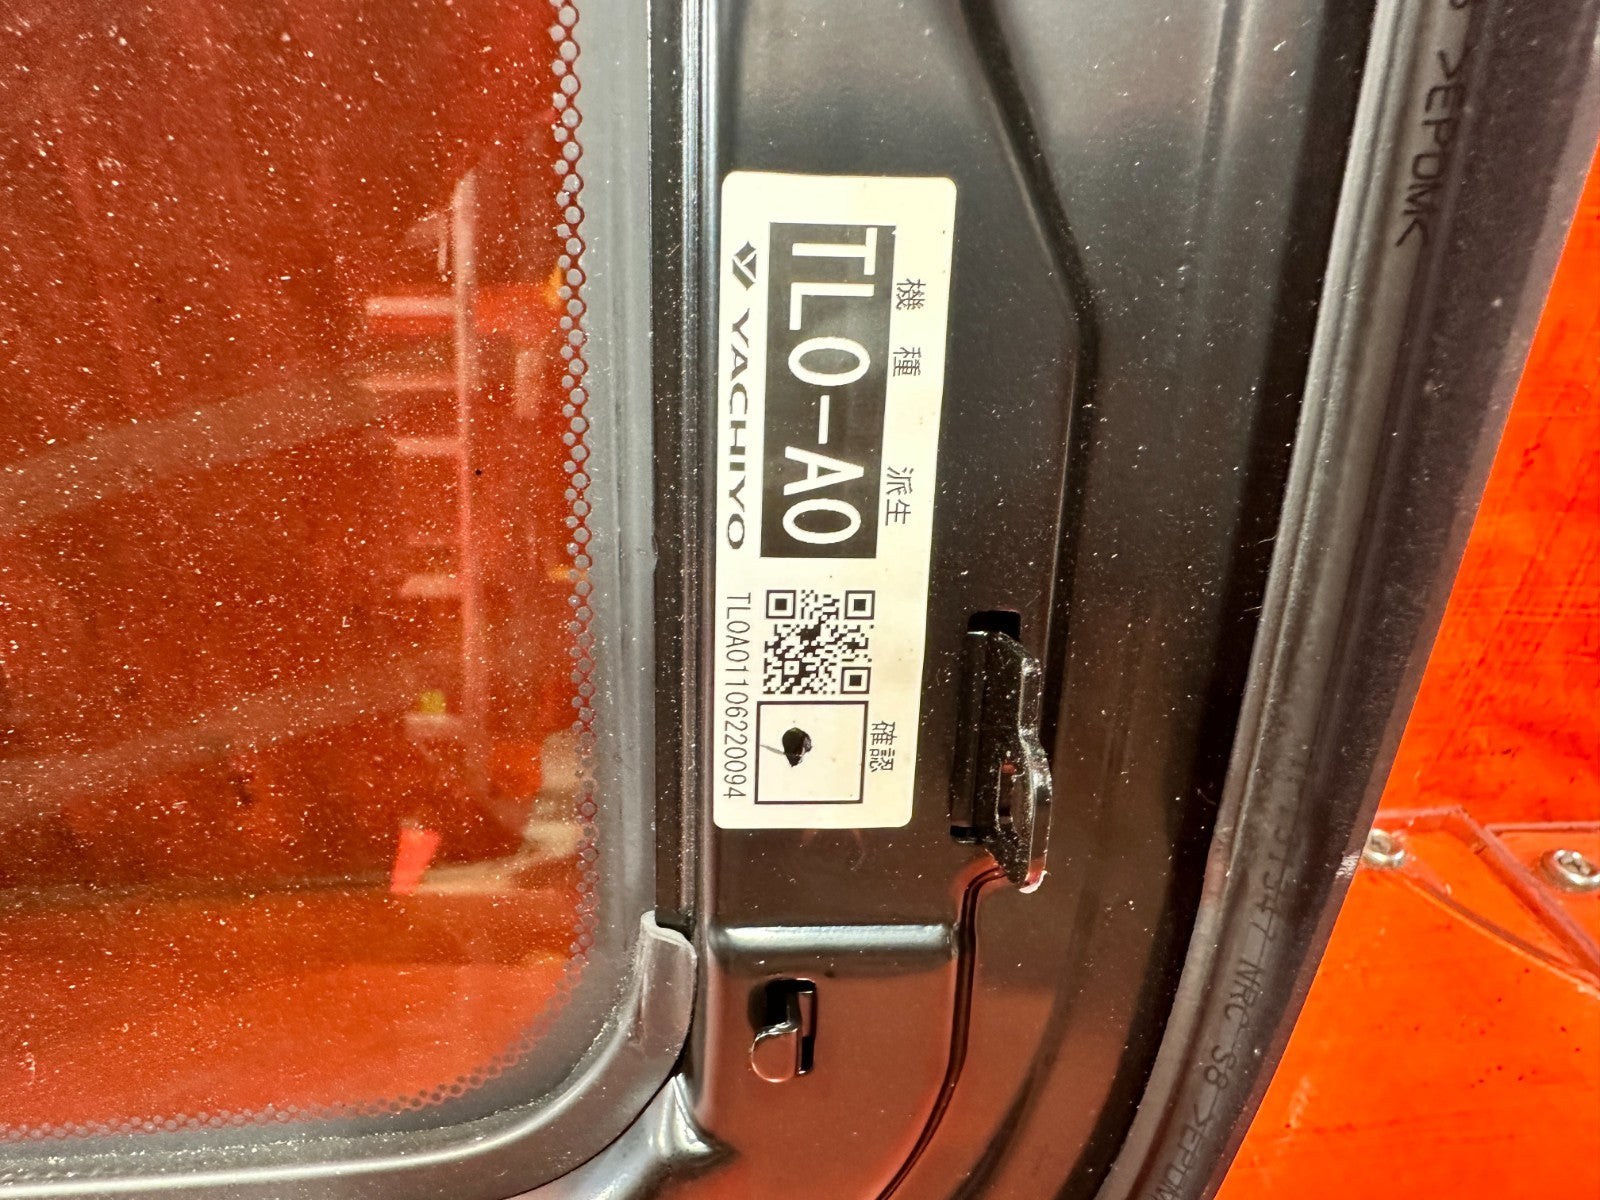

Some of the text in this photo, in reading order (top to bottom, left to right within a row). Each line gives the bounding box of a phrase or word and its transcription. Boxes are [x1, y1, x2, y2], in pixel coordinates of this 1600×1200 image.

[726, 307, 750, 550] YACHIYO
[885, 466, 914, 526] 派生
[869, 720, 897, 773] 確認
[1204, 1045, 1237, 1090] S8
